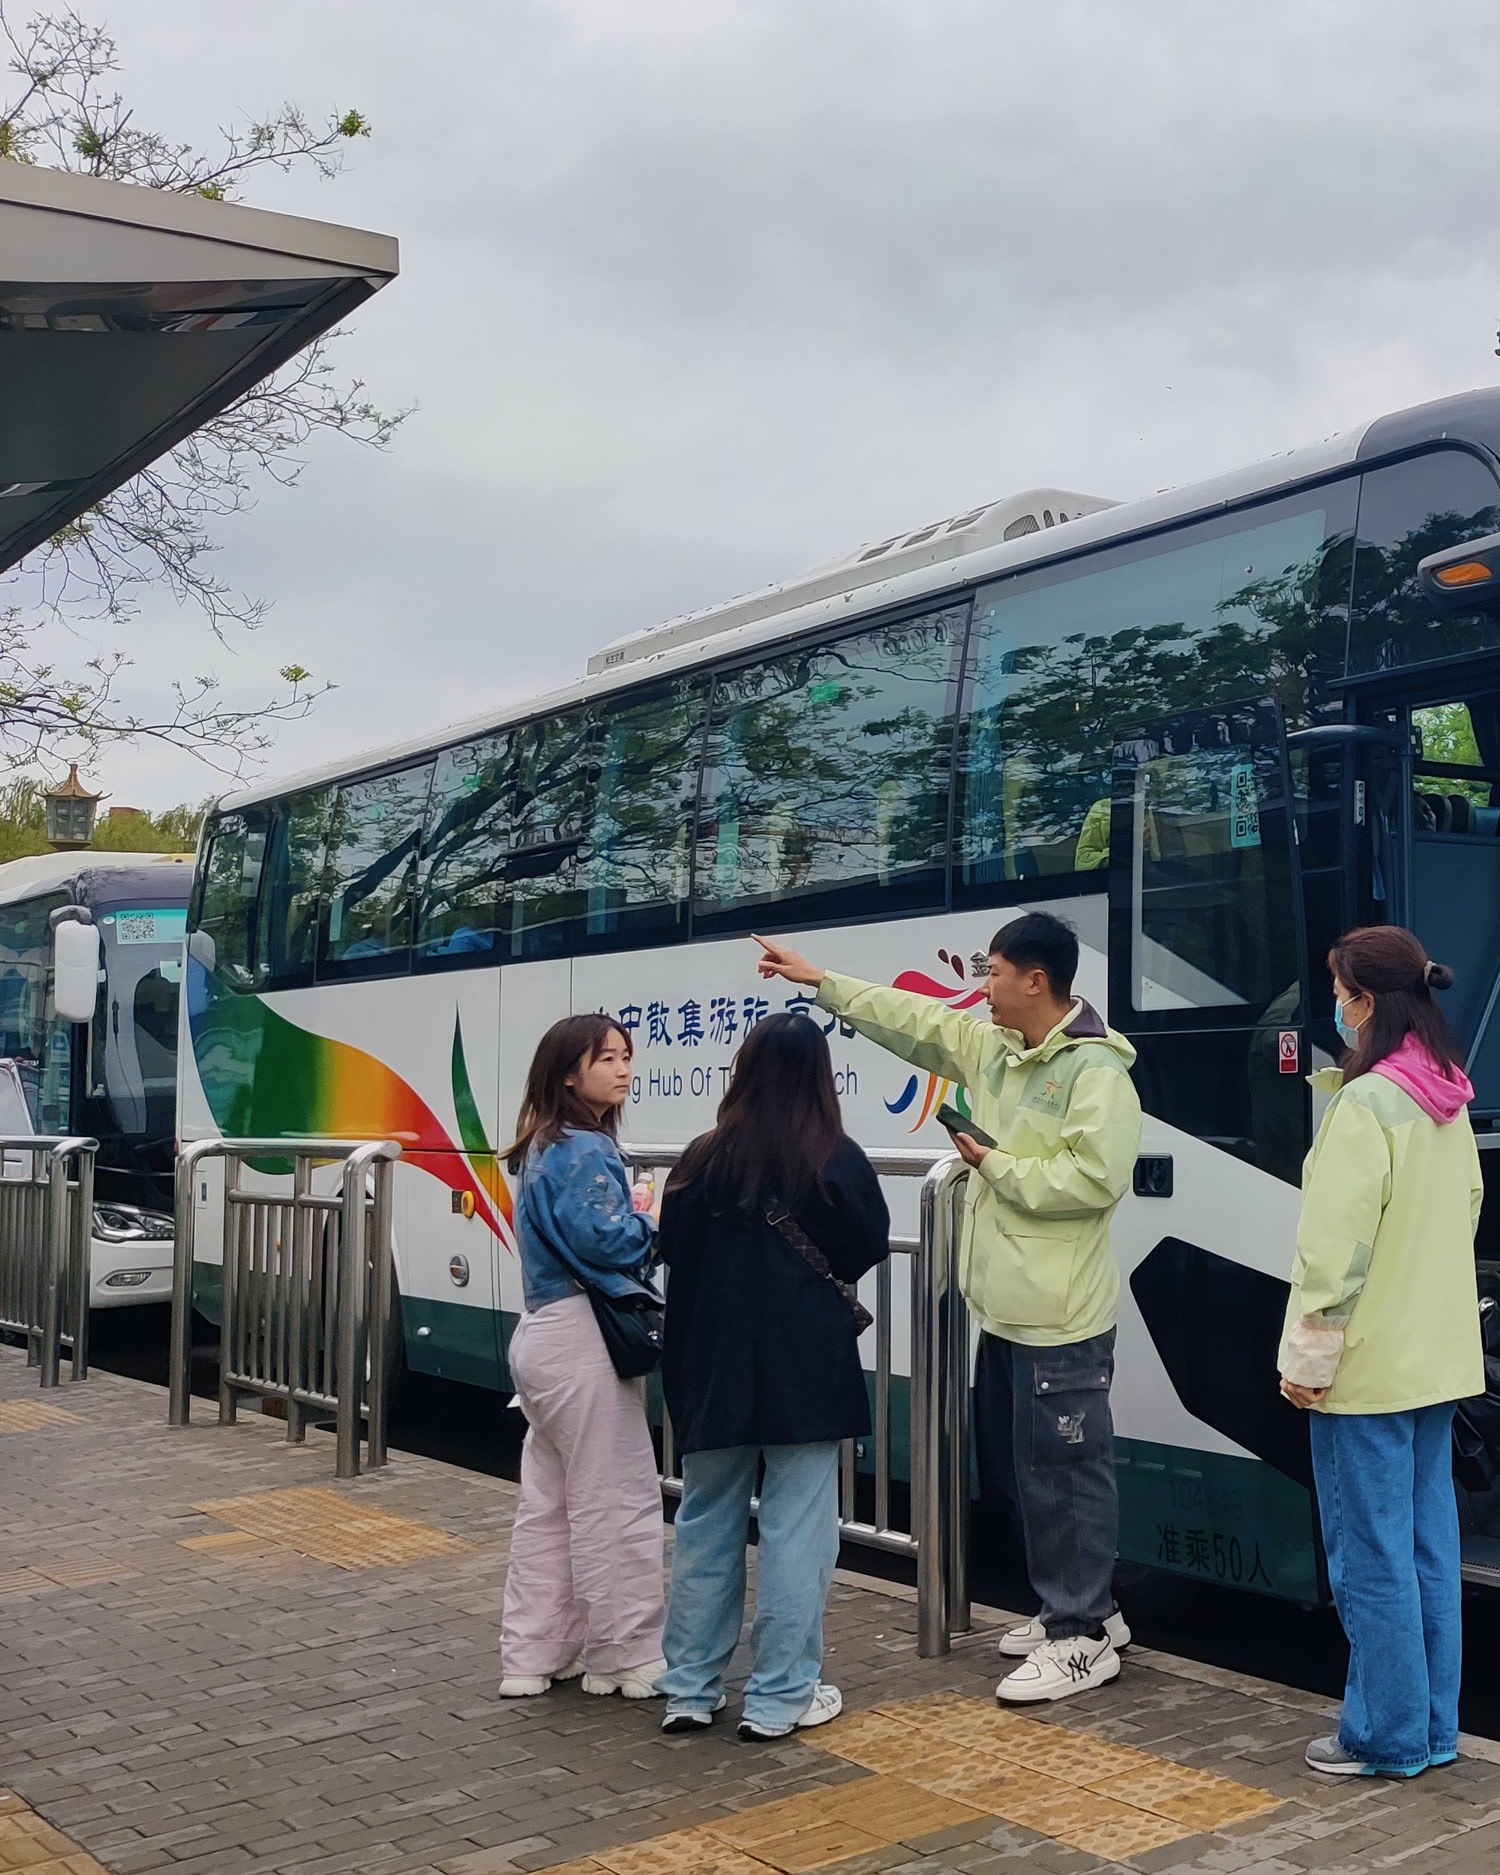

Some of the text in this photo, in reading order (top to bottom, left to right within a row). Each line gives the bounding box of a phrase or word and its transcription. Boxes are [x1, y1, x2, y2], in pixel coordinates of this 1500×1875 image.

[649, 1068, 682, 1096] Hub
[691, 1067, 712, 1096] Of
[1067, 1650, 1091, 1683] NY
